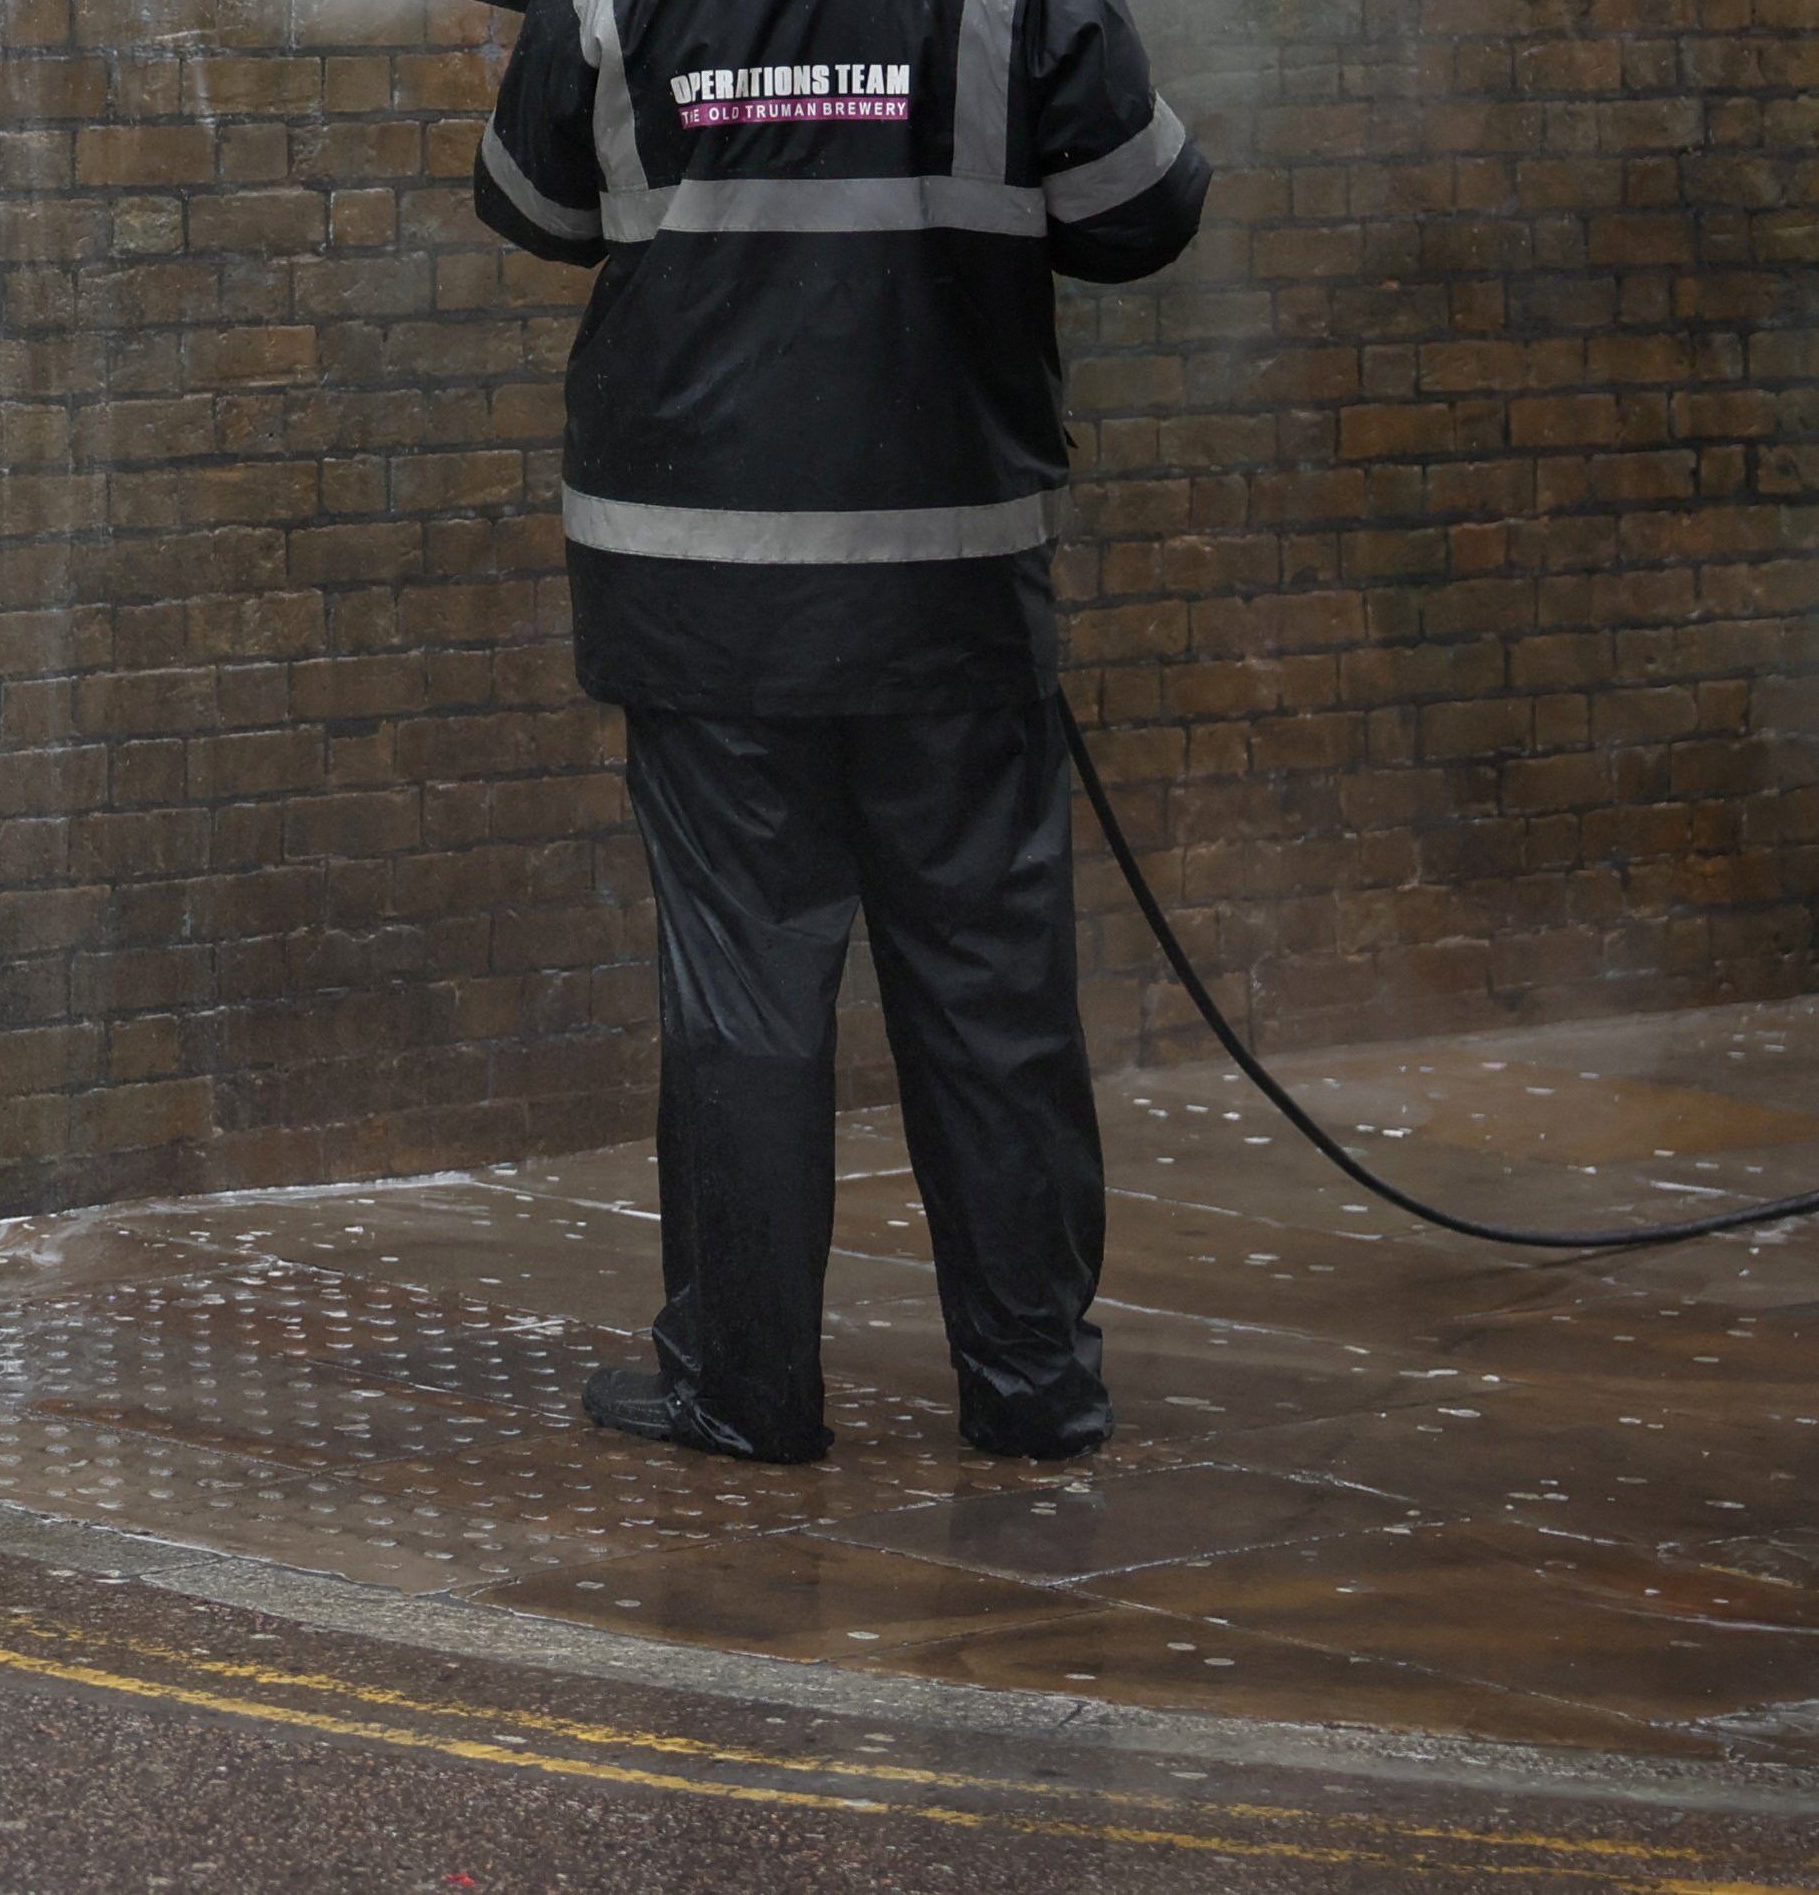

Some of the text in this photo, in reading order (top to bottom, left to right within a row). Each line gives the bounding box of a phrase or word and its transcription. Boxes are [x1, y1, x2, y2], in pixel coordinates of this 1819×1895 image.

[670, 64, 910, 105] OPERATIONS TEAM
[709, 106, 740, 121] OLD
[746, 102, 816, 119] TRUMAN
[823, 101, 906, 116] BREWERY
